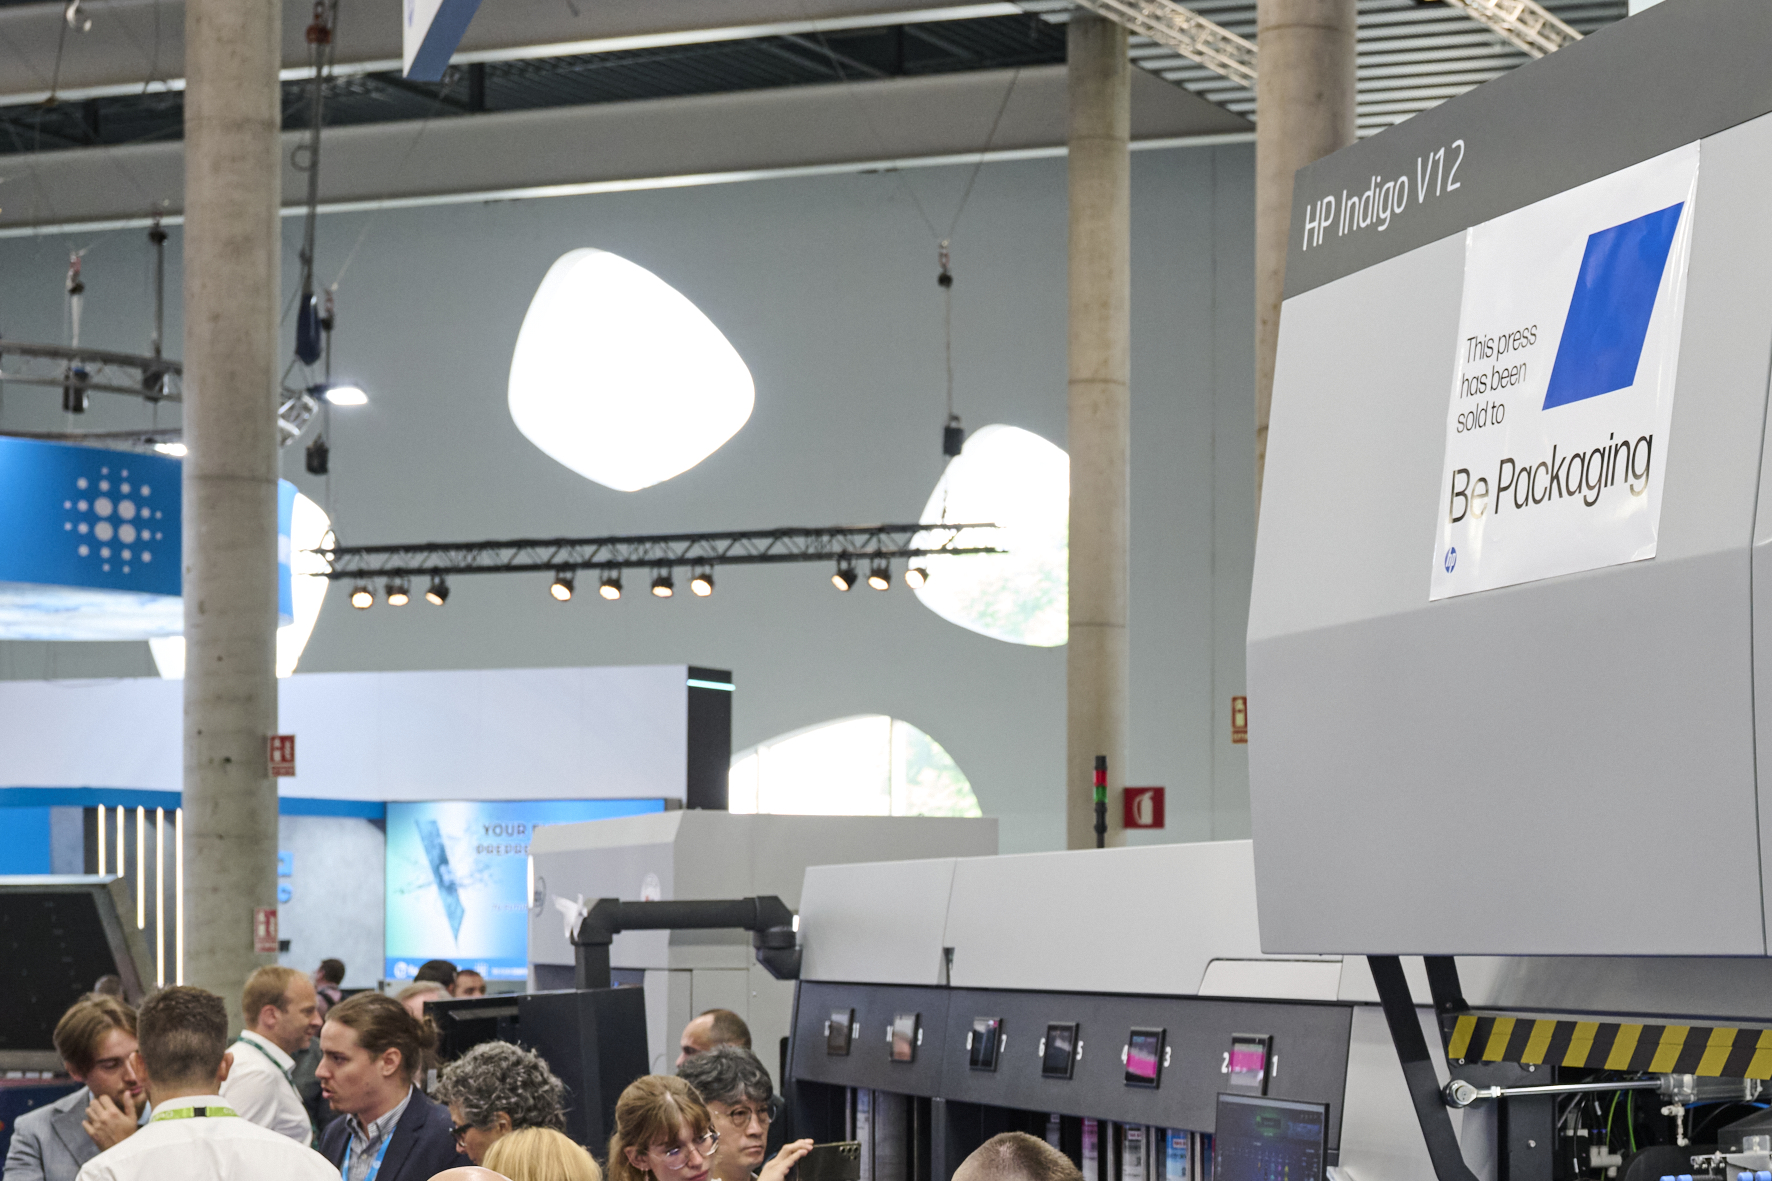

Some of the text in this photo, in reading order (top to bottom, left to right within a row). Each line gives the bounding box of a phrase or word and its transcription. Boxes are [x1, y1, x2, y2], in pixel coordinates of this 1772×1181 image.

[1303, 139, 1465, 251] HP Indigo V12
[1466, 324, 1538, 364] This press
[1460, 362, 1527, 399] has been
[1456, 400, 1506, 434] sold to
[1449, 432, 1654, 524] Be Packaging
[1445, 547, 1457, 574] hp
[483, 823, 527, 837] YOUR
[852, 1022, 860, 1039] 11
[917, 1027, 924, 1046] 9
[1000, 1033, 1008, 1053] 7
[1038, 1037, 1046, 1058] 6
[1075, 1040, 1084, 1061] 5
[1120, 1044, 1129, 1065] 4
[1163, 1046, 1172, 1068] 3
[1221, 1052, 1230, 1074] 2
[1271, 1055, 1279, 1077] 1
